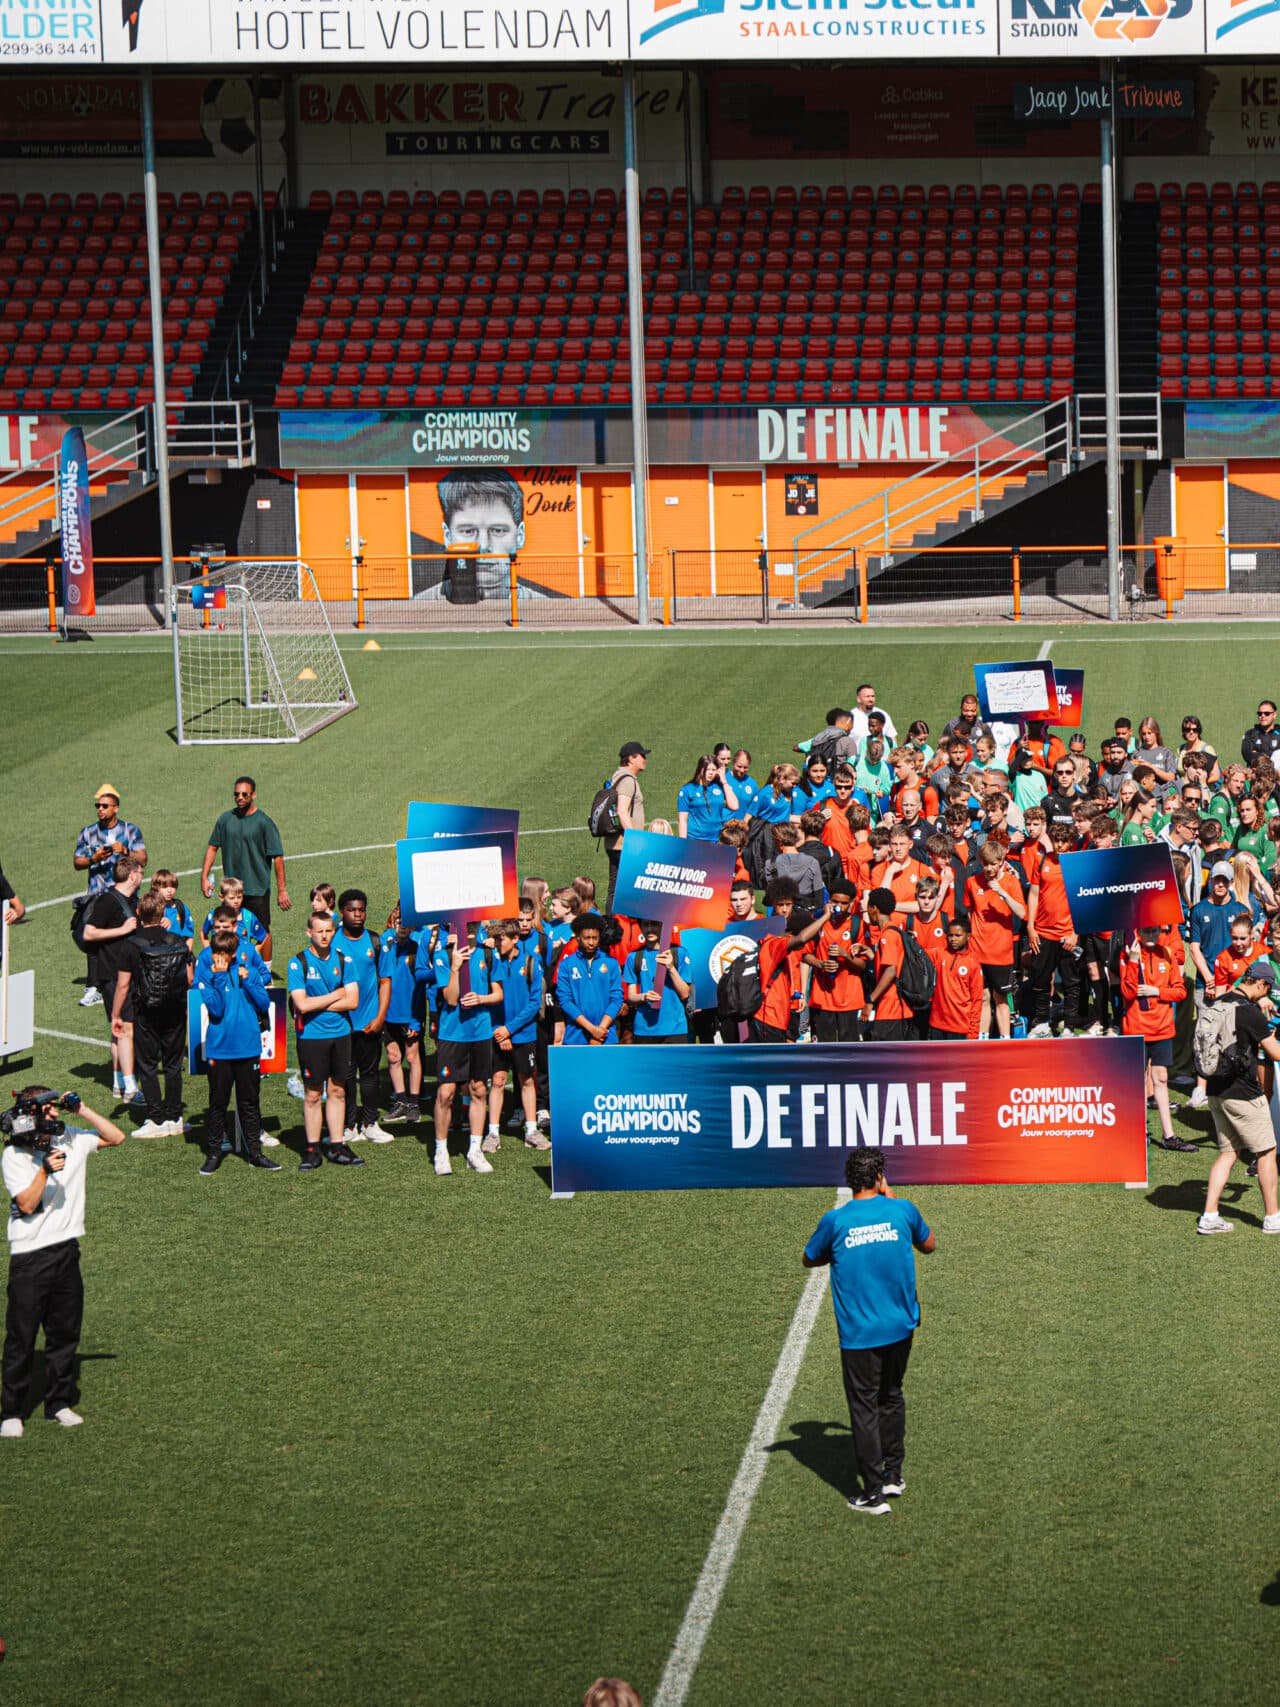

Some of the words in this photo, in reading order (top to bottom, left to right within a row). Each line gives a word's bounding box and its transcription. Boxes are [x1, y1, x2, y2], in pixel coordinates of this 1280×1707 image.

[236, 11, 365, 50] HOTEL
[377, 9, 612, 49] VOLENDAM
[739, 20, 986, 37] STAALCONSTRUCTIES
[1011, 23, 1078, 38] STADION
[58, 43, 75, 55] 34
[80, 43, 96, 55] 41
[299, 82, 526, 123] BAKKER
[1024, 84, 1068, 116] Jaap
[1071, 84, 1112, 116] Jonk
[1119, 84, 1184, 108] Tribune
[397, 135, 601, 152] TOURINGCARS
[425, 412, 517, 428] COMMUNITY
[412, 428, 531, 452] CHAMPIONS
[758, 408, 808, 461] DE
[814, 407, 950, 461] FINALE
[435, 453, 458, 463] Jouw
[460, 453, 510, 464] voorsprong
[523, 466, 573, 487] Wim
[526, 491, 576, 516] Jonk
[67, 460, 85, 575] CHAMPIONS
[645, 862, 682, 879] SAMEN
[680, 867, 707, 883] VOOR
[634, 875, 714, 900] KWETSBAARHEID
[1077, 886, 1105, 897] Jouw
[1106, 880, 1165, 893] voorsprong
[594, 1093, 688, 1111] COMMUNITY
[1010, 1086, 1103, 1104] COMMUNITY
[582, 1109, 701, 1135] CHAMPIONS
[730, 1085, 792, 1149] DE
[801, 1082, 968, 1148] FINALE
[997, 1102, 1116, 1128] CHAMPIONS
[604, 1136, 628, 1145] Jouw
[629, 1135, 680, 1146] voorsprong
[1020, 1128, 1042, 1137] Jouw
[1044, 1128, 1094, 1138] voorsprong
[844, 1229, 899, 1248] CHAMPIONS
[848, 1222, 892, 1236] COMMUNITY
